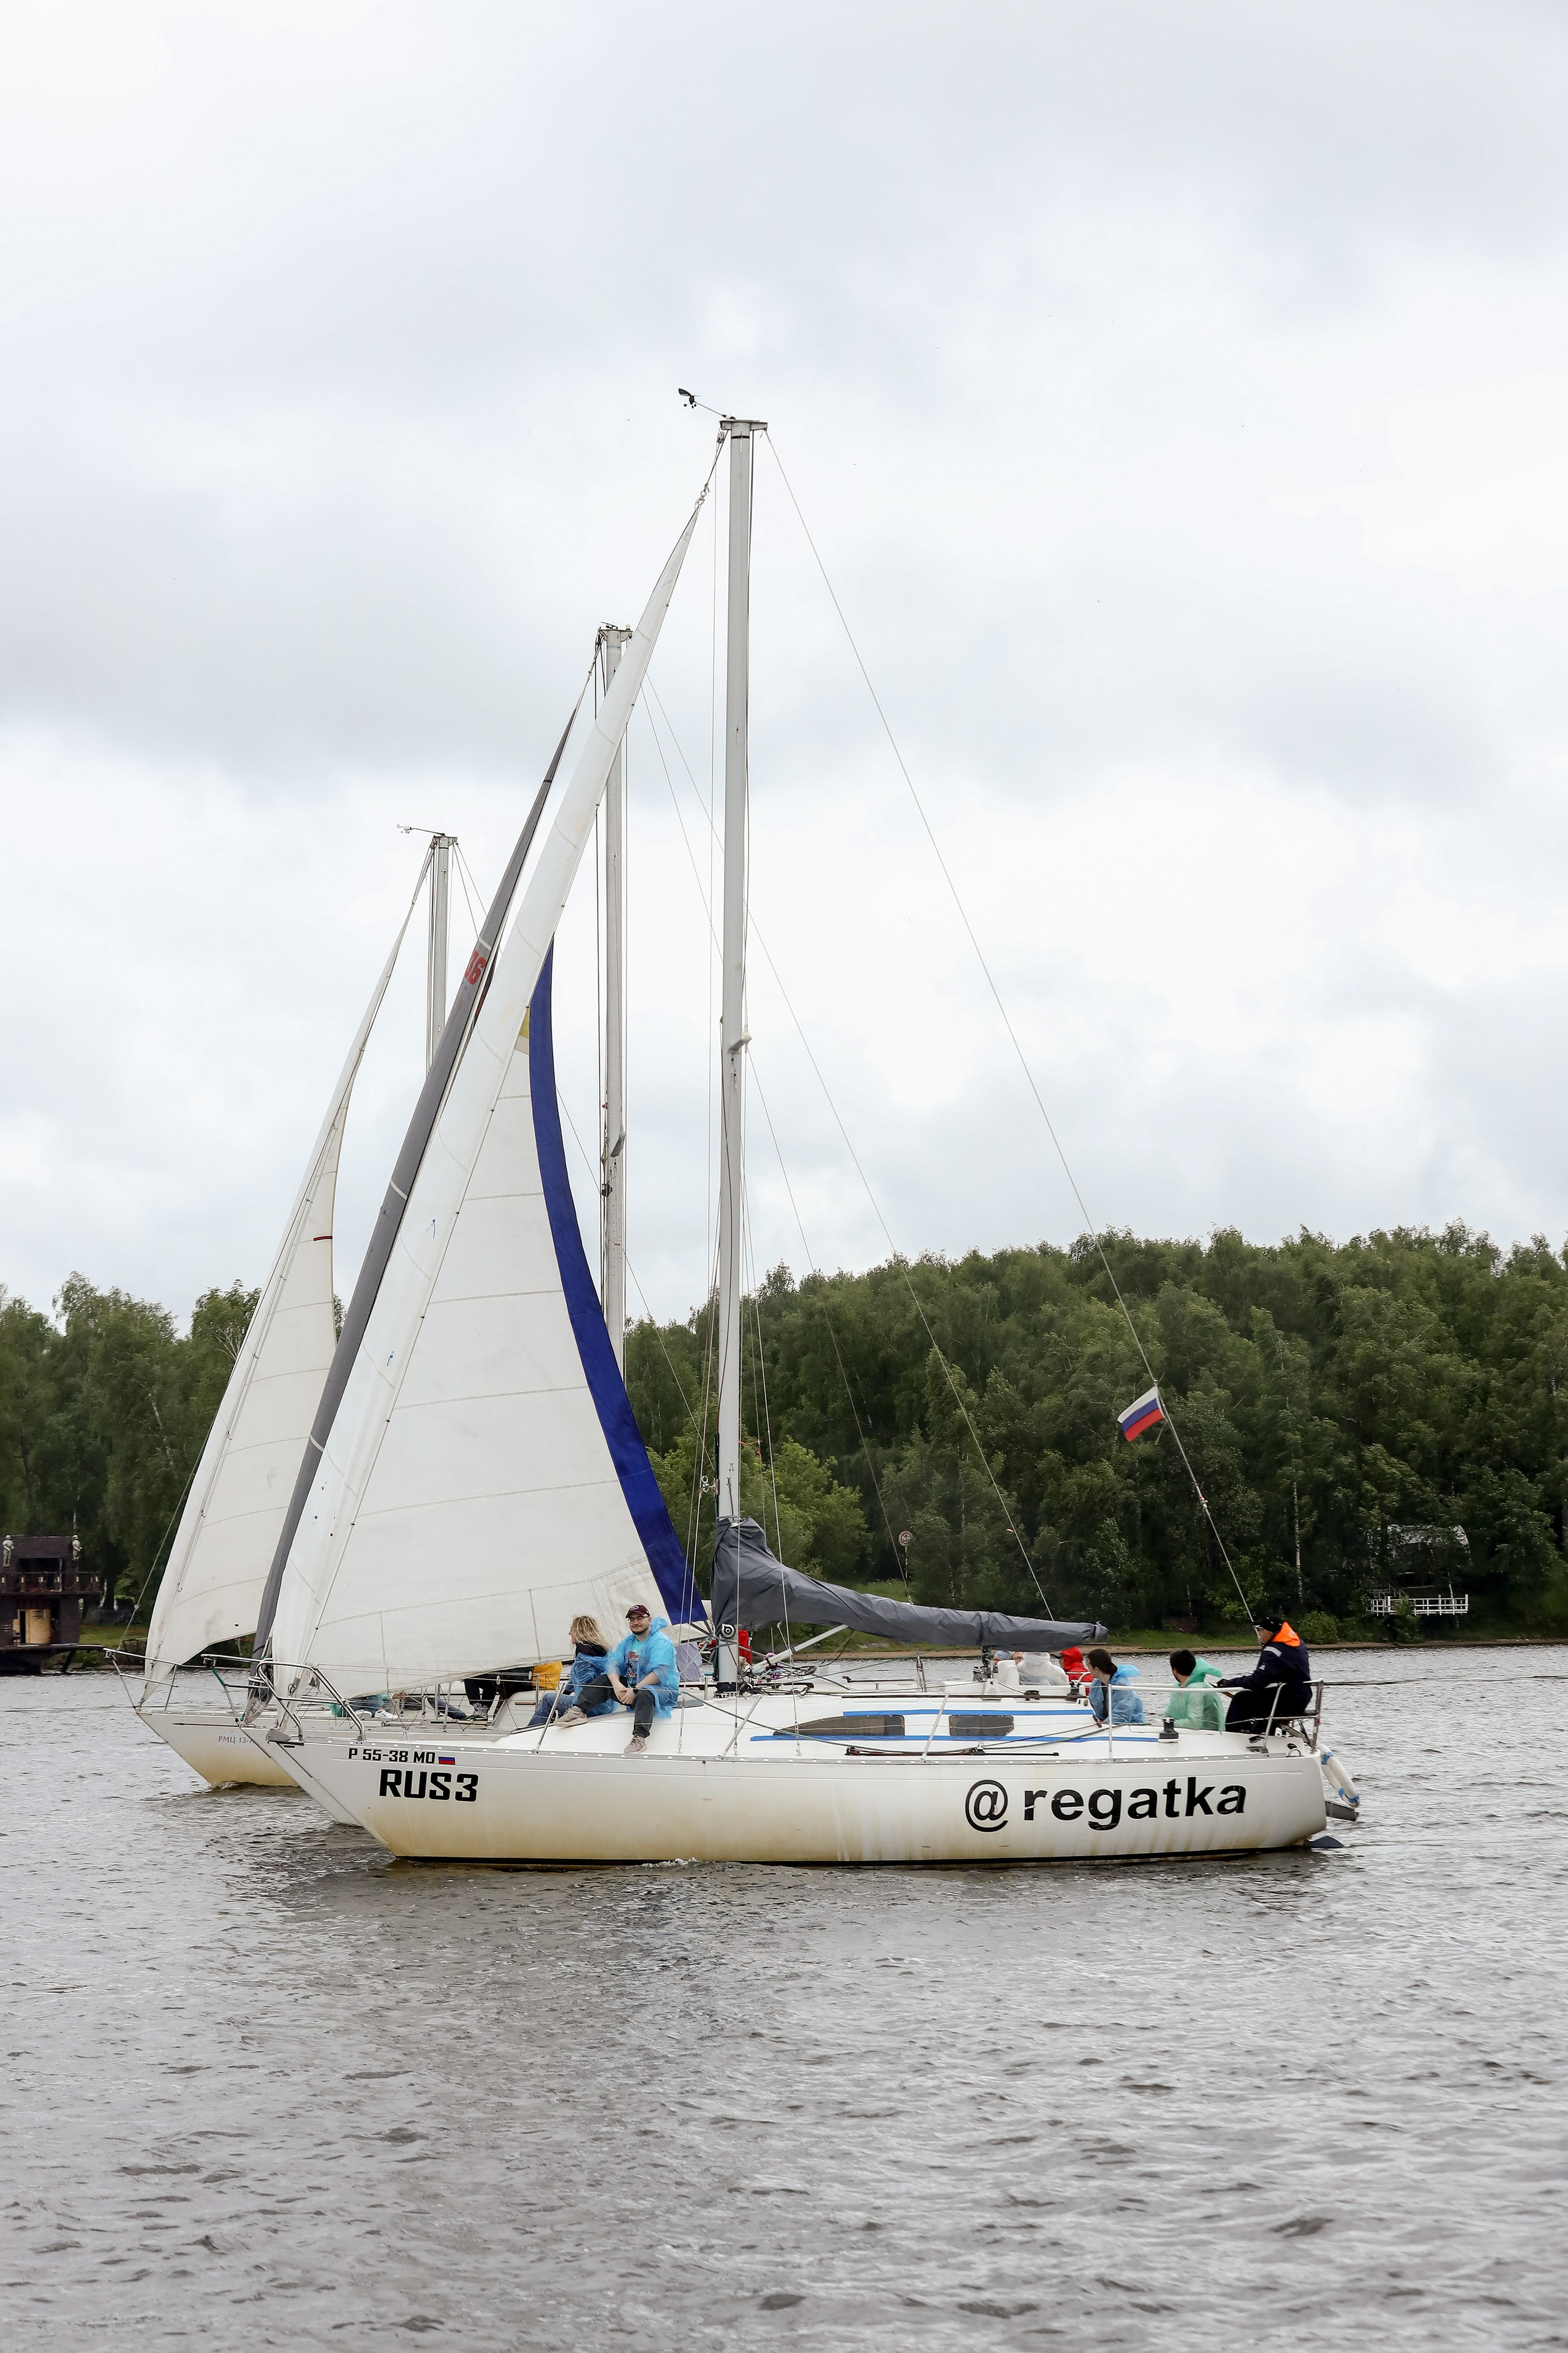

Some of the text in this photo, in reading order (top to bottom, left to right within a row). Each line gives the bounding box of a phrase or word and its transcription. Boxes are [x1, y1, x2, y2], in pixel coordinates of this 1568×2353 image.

[218, 1735, 236, 1744] РМЦ
[363, 1749, 409, 1762] 55-38
[379, 1769, 478, 1802] RUS3
